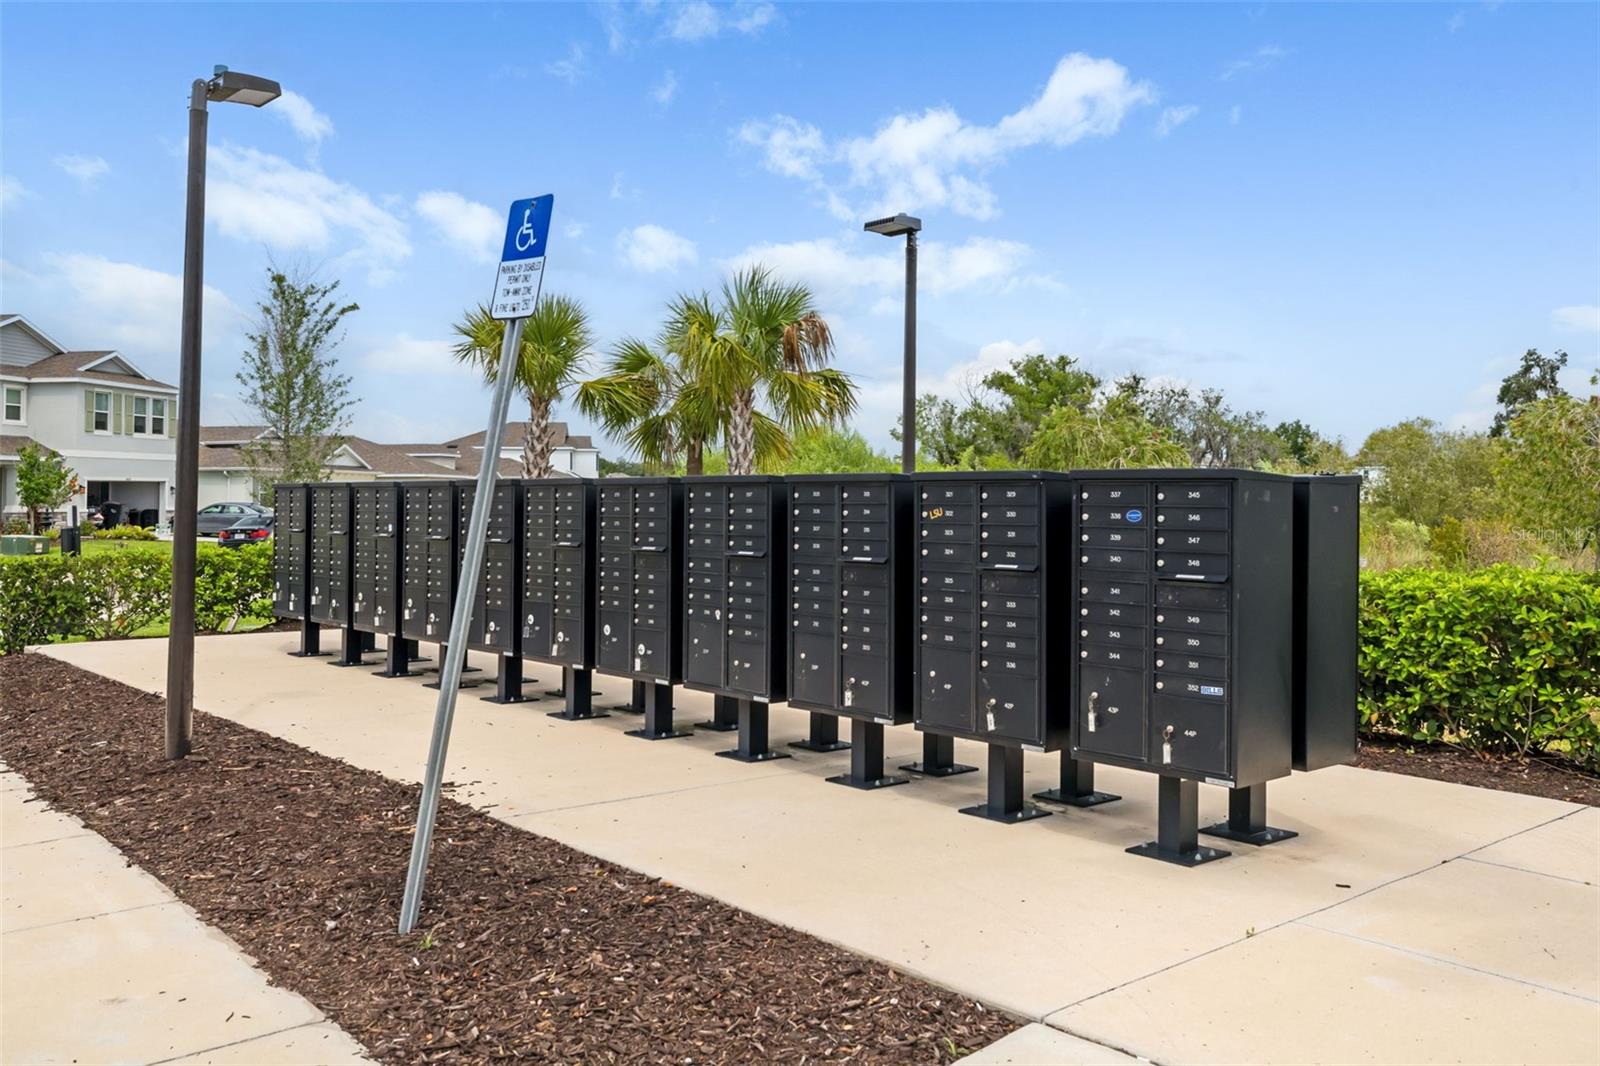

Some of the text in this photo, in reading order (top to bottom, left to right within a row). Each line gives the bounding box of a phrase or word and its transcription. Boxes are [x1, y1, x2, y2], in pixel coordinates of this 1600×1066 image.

[1187, 491, 1201, 499] 345
[929, 508, 944, 520] LSU
[1187, 513, 1201, 522] 346
[1109, 533, 1122, 542] 339
[1109, 555, 1122, 563] 340
[1187, 559, 1201, 567] 348
[1109, 608, 1121, 617] 342
[1186, 615, 1200, 624] 349
[1108, 630, 1121, 639] 343
[1186, 638, 1200, 647] 350
[1108, 652, 1121, 660] 344
[1187, 660, 1199, 669] 351
[1186, 683, 1200, 692] 352
